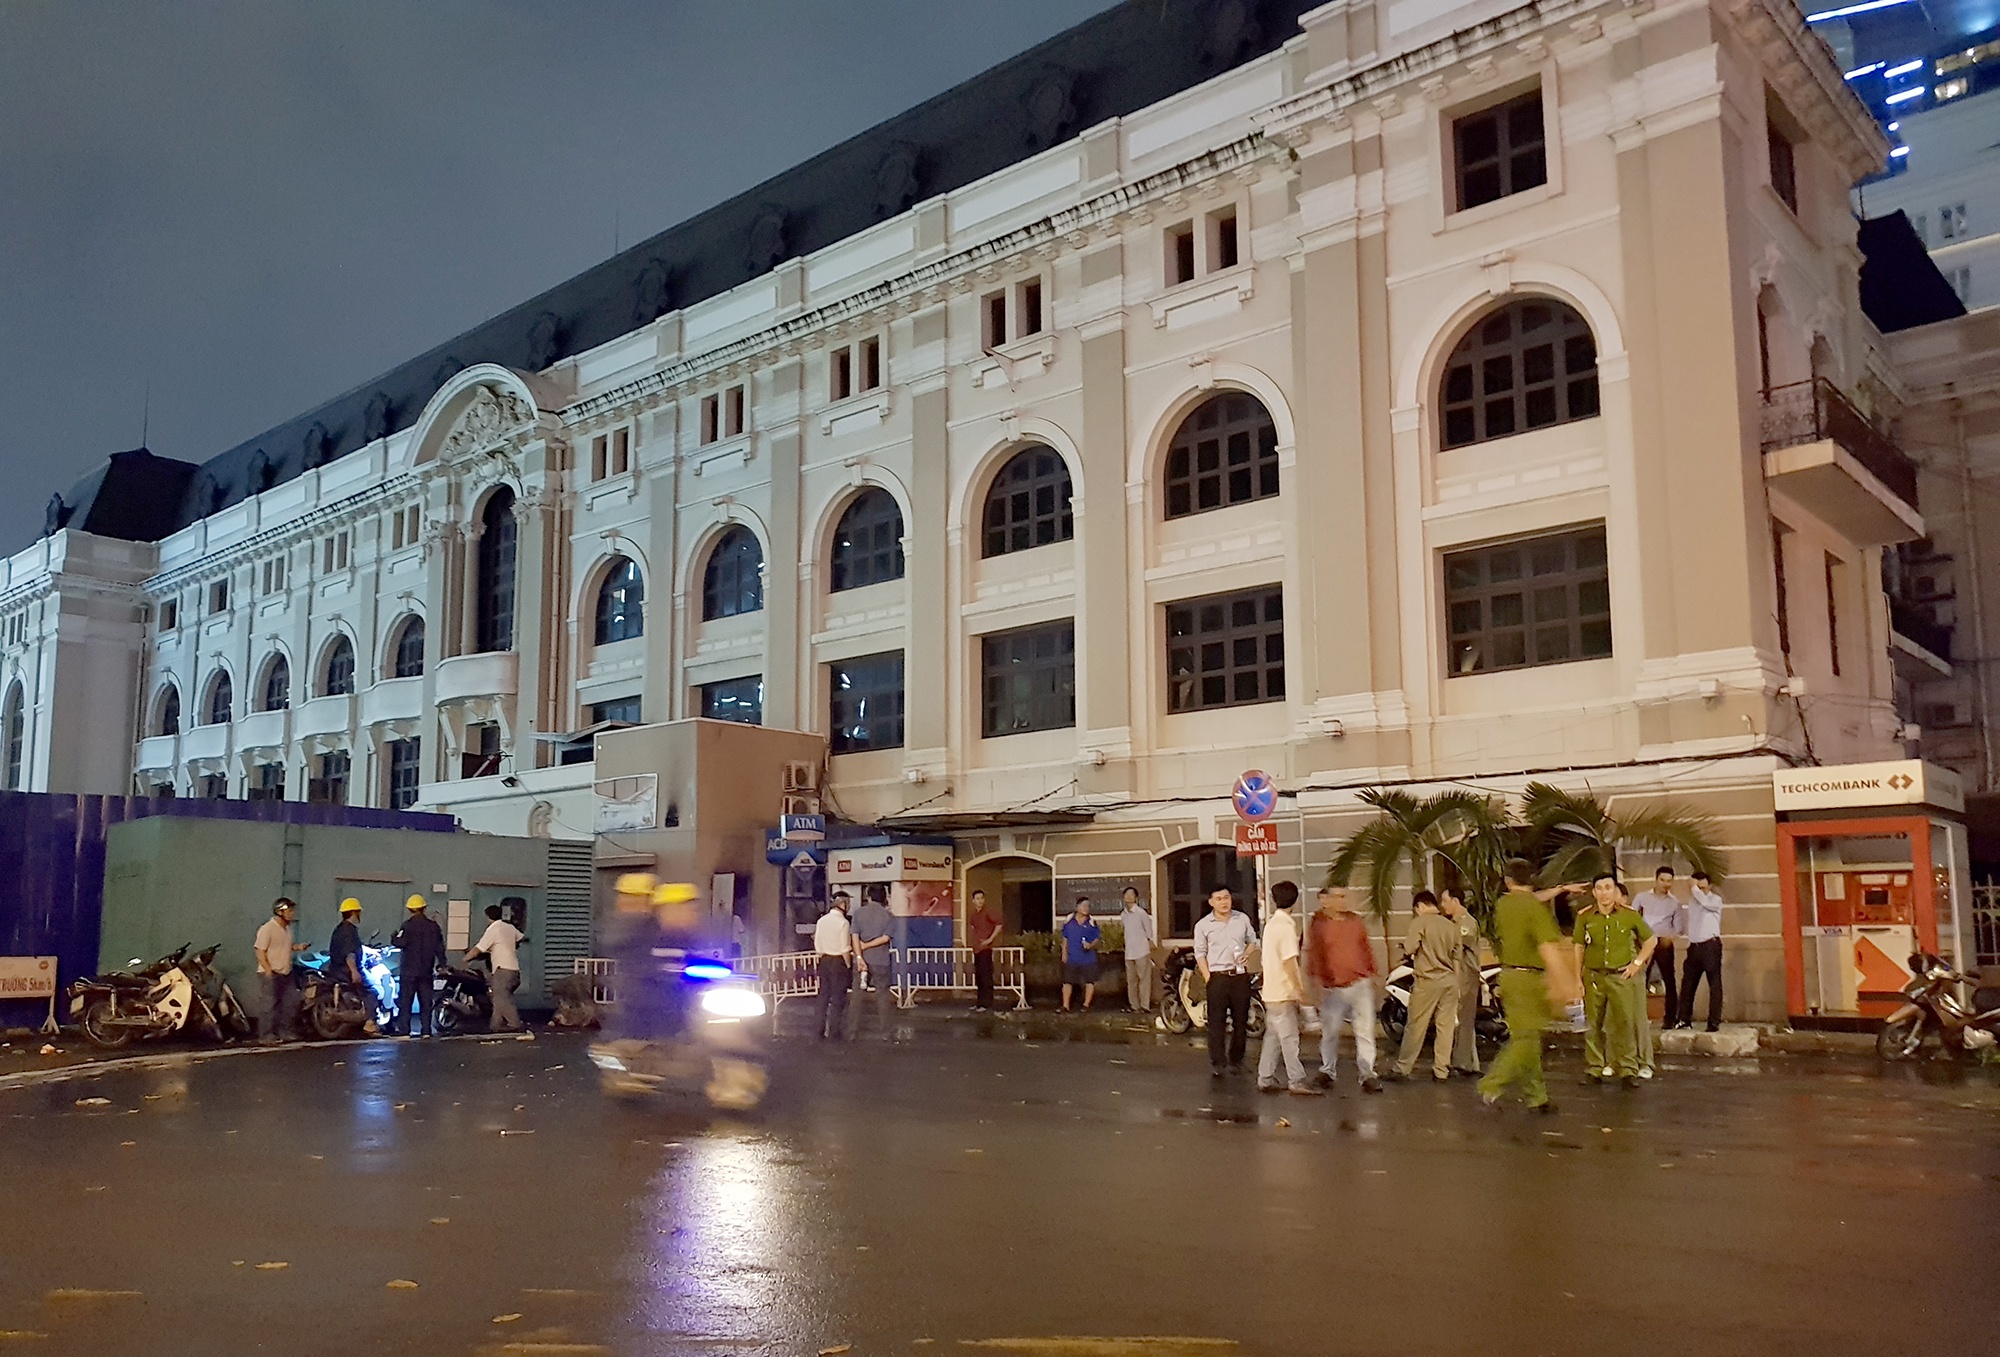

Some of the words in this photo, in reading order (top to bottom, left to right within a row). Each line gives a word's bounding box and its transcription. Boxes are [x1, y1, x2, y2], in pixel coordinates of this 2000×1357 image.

[1781, 779, 1881, 794] TECHCOMBANK
[793, 817, 816, 829] ATM
[767, 838, 788, 851] ACB
[1823, 926, 1843, 935] VISA
